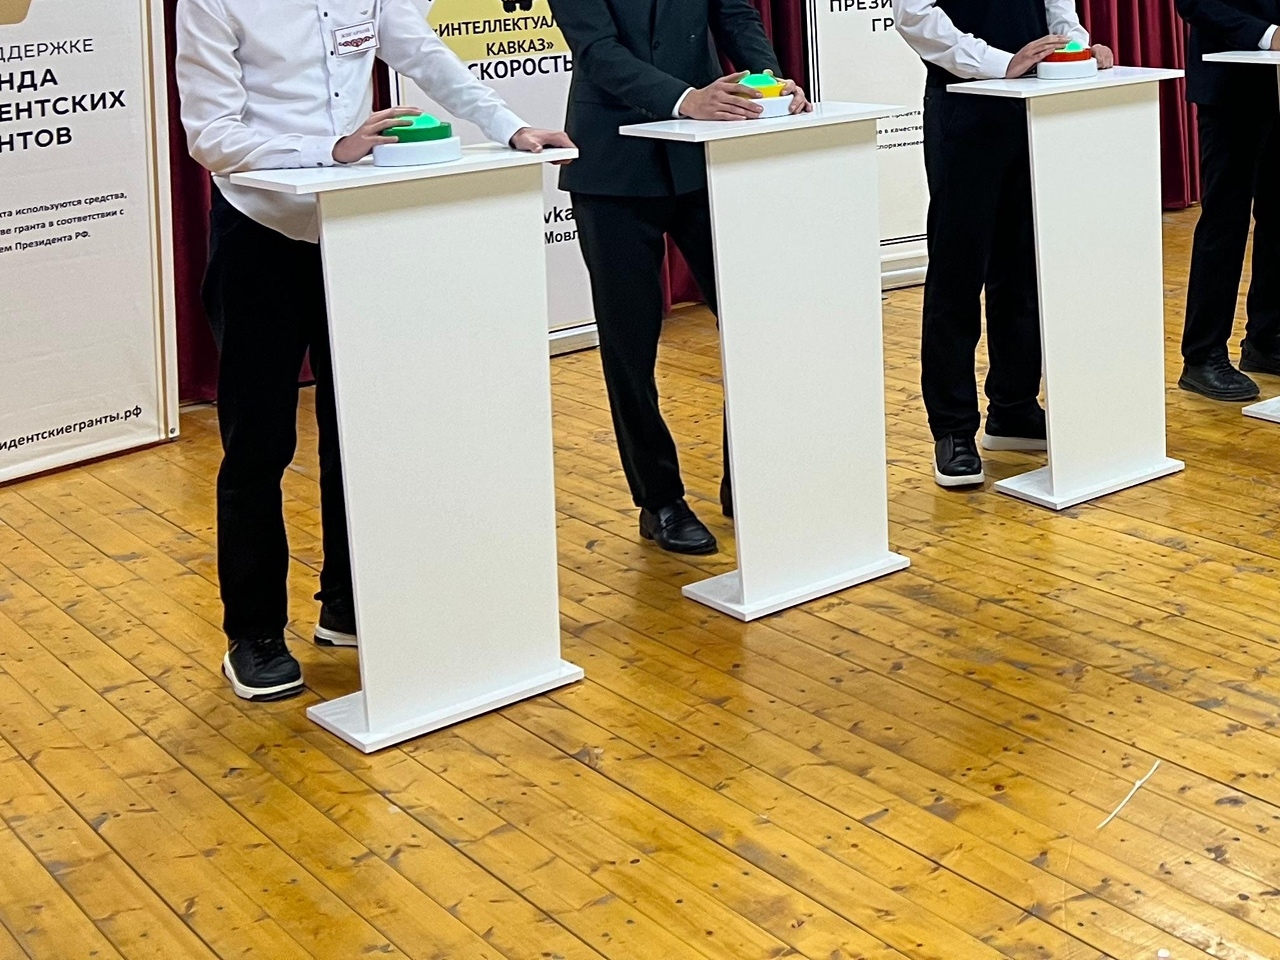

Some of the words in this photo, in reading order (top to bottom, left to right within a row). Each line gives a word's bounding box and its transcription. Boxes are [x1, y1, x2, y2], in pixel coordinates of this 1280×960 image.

[486, 38, 554, 57] КАВКАЗ»
[0, 90, 126, 122] ЕНТСКИХ
[15, 199, 82, 216] используются
[84, 192, 127, 206] средства,
[14, 223, 46, 234] гранта
[56, 209, 118, 227] соответствии
[15, 234, 73, 251] Президента
[75, 230, 91, 240] РФ.
